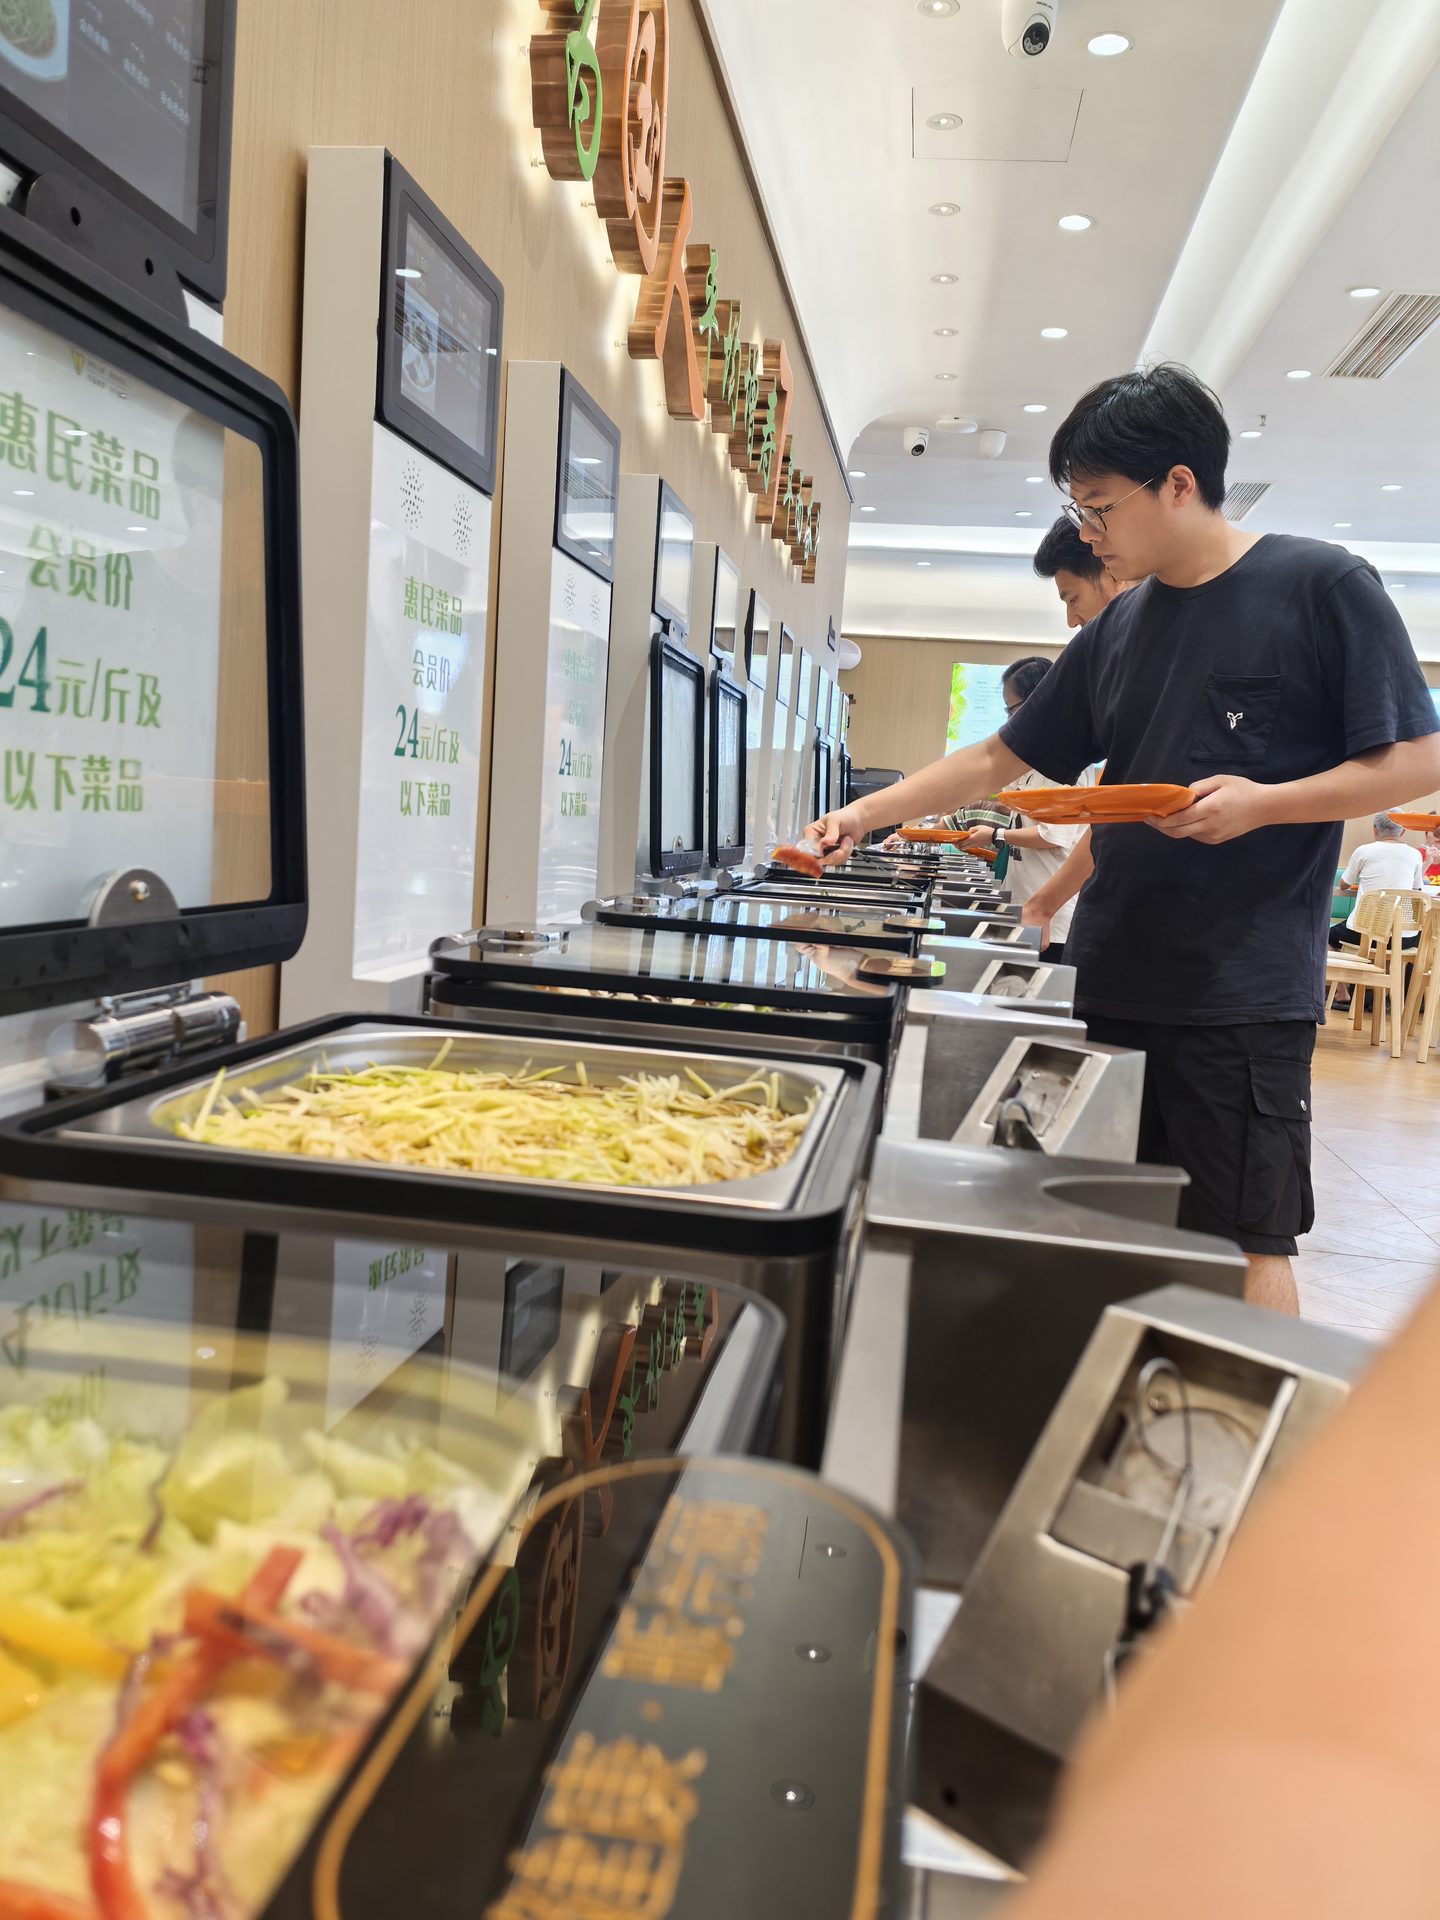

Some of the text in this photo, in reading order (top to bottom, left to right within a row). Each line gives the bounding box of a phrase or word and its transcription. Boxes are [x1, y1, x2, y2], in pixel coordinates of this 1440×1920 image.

[0, 391, 160, 521] 惠民菜品
[27, 524, 134, 610] 会员价
[404, 576, 462, 637] 惠民菜品
[412, 649, 450, 693] 会员价
[394, 704, 460, 764] 24元/斤及
[4, 749, 144, 812] 以下菜品
[400, 781, 450, 816] 以下菜品
